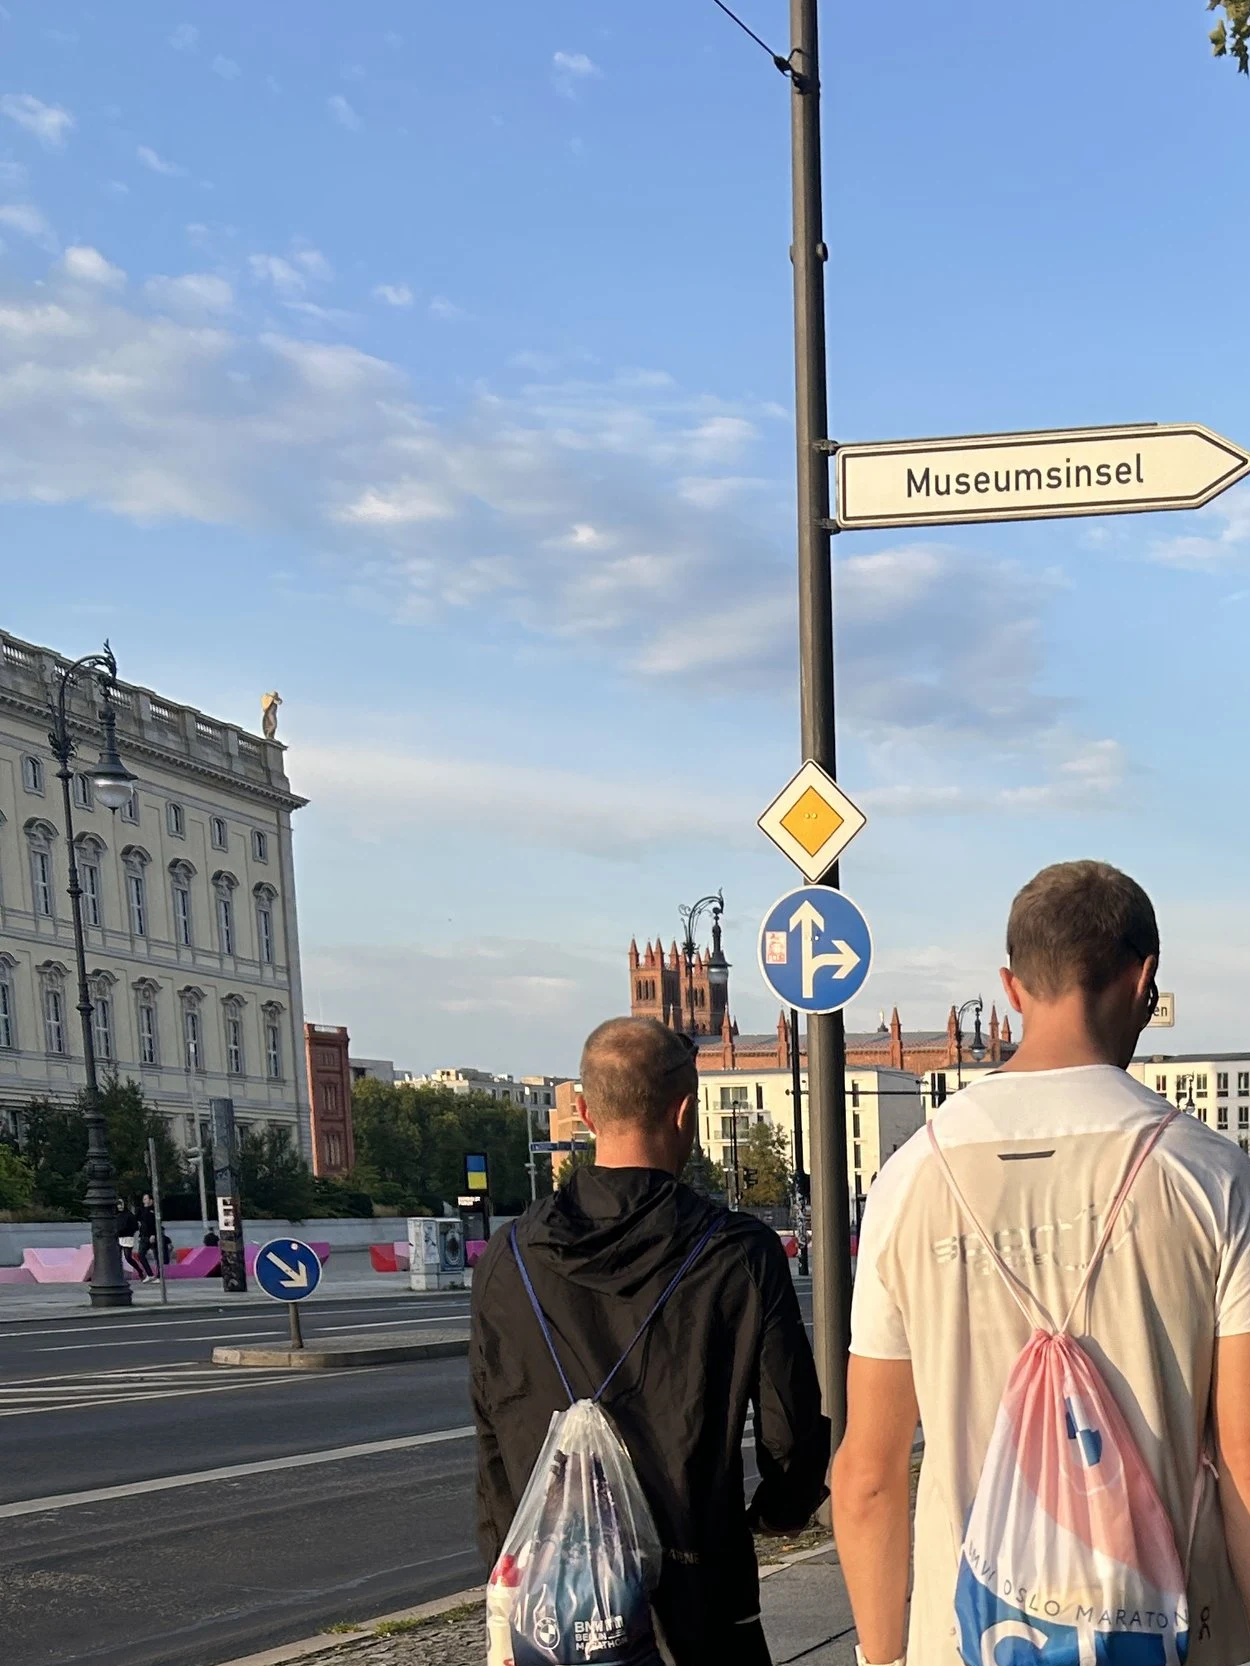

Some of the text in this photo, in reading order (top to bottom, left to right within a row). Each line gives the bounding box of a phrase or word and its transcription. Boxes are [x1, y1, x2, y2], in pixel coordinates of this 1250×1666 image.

[906, 453, 1144, 498] Museumsinsel
[1003, 1579, 1061, 1617] OSLO
[1075, 1605, 1188, 1629] MARATON
